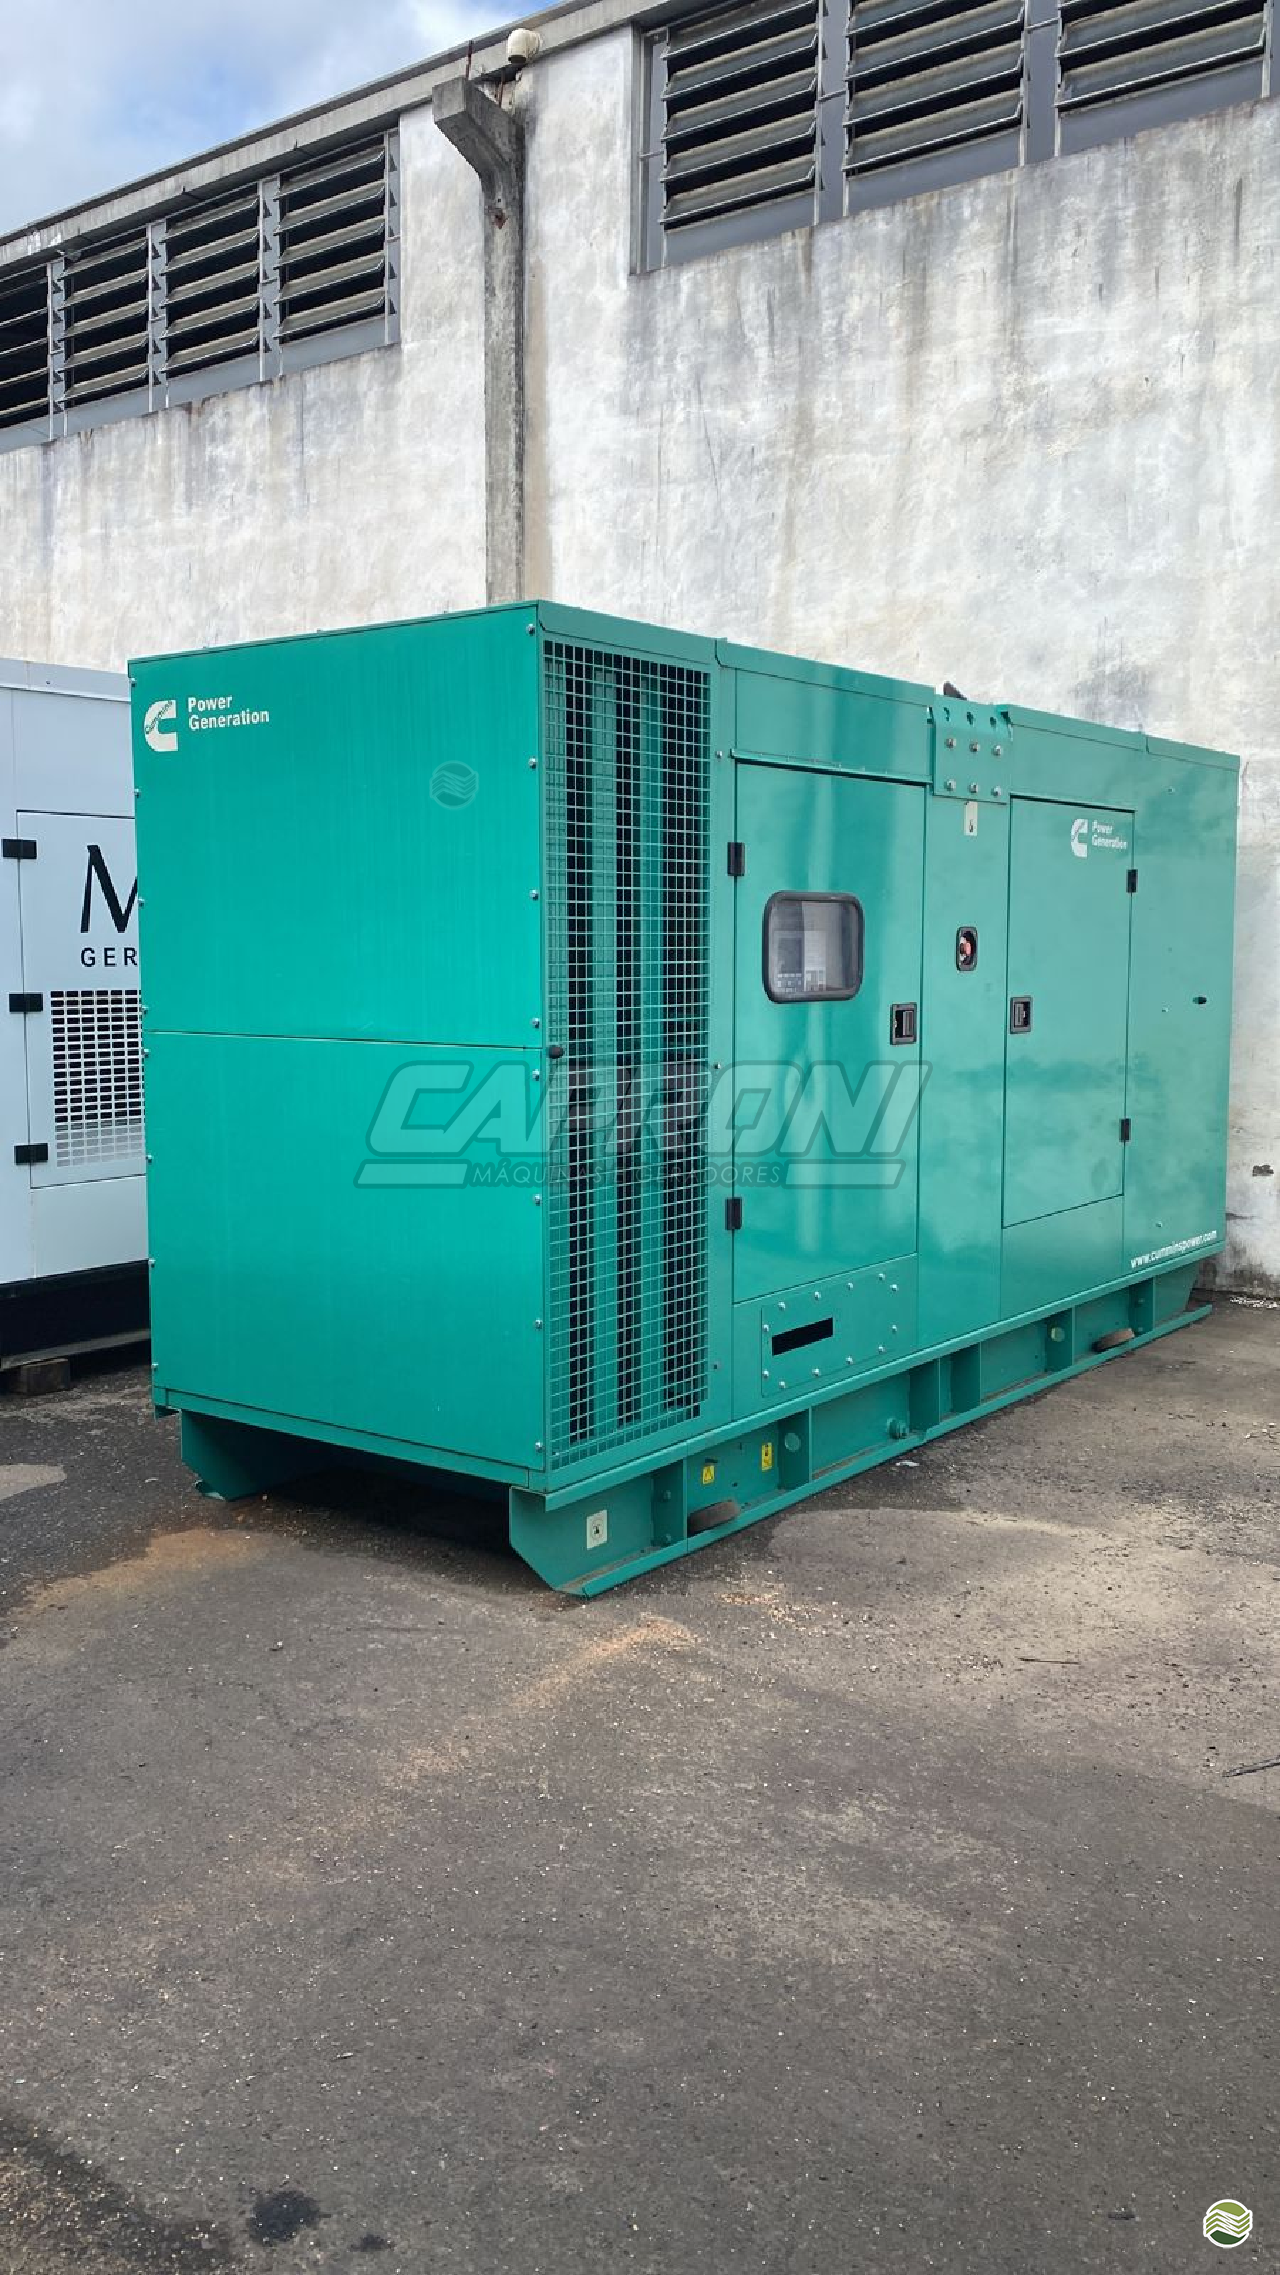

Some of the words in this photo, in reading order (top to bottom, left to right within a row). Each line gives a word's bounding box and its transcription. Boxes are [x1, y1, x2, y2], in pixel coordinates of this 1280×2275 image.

[188, 695, 232, 712] Power
[188, 709, 270, 730] Generation
[1092, 820, 1113, 833] Power
[1092, 833, 1127, 849] Generation
